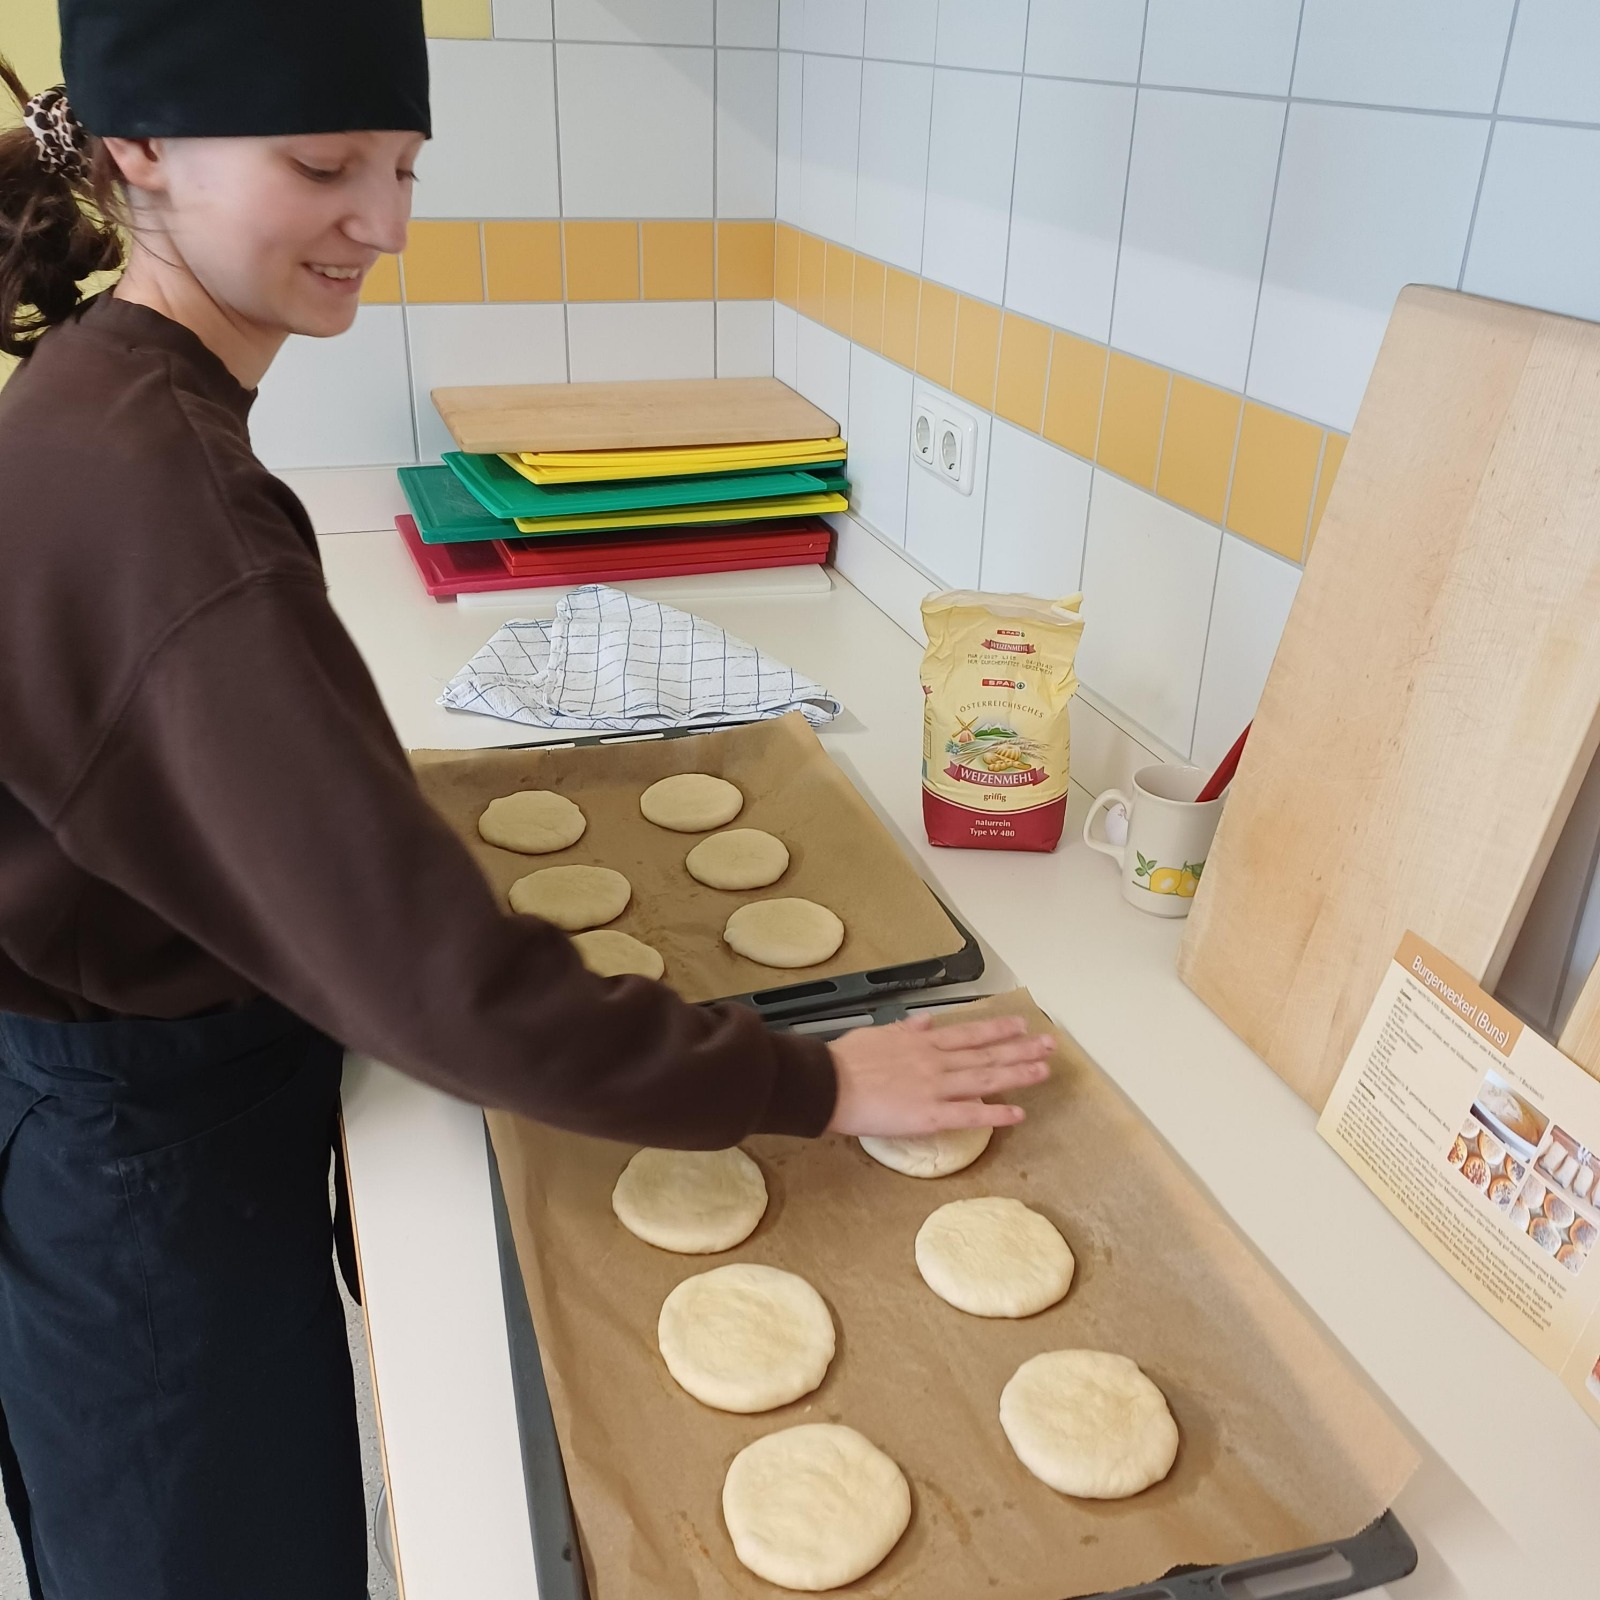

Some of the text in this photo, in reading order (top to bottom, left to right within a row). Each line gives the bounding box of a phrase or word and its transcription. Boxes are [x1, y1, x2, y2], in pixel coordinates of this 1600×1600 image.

[990, 641, 1028, 651] WEIZENMEHL
[960, 767, 1034, 785] WEIZENMEHL
[983, 793, 1007, 802] griffig
[975, 819, 1011, 827] naturrein
[969, 827, 988, 837] Type
[1411, 954, 1477, 1020] Burgerweckerl
[1475, 1009, 1510, 1049] (Buns)
